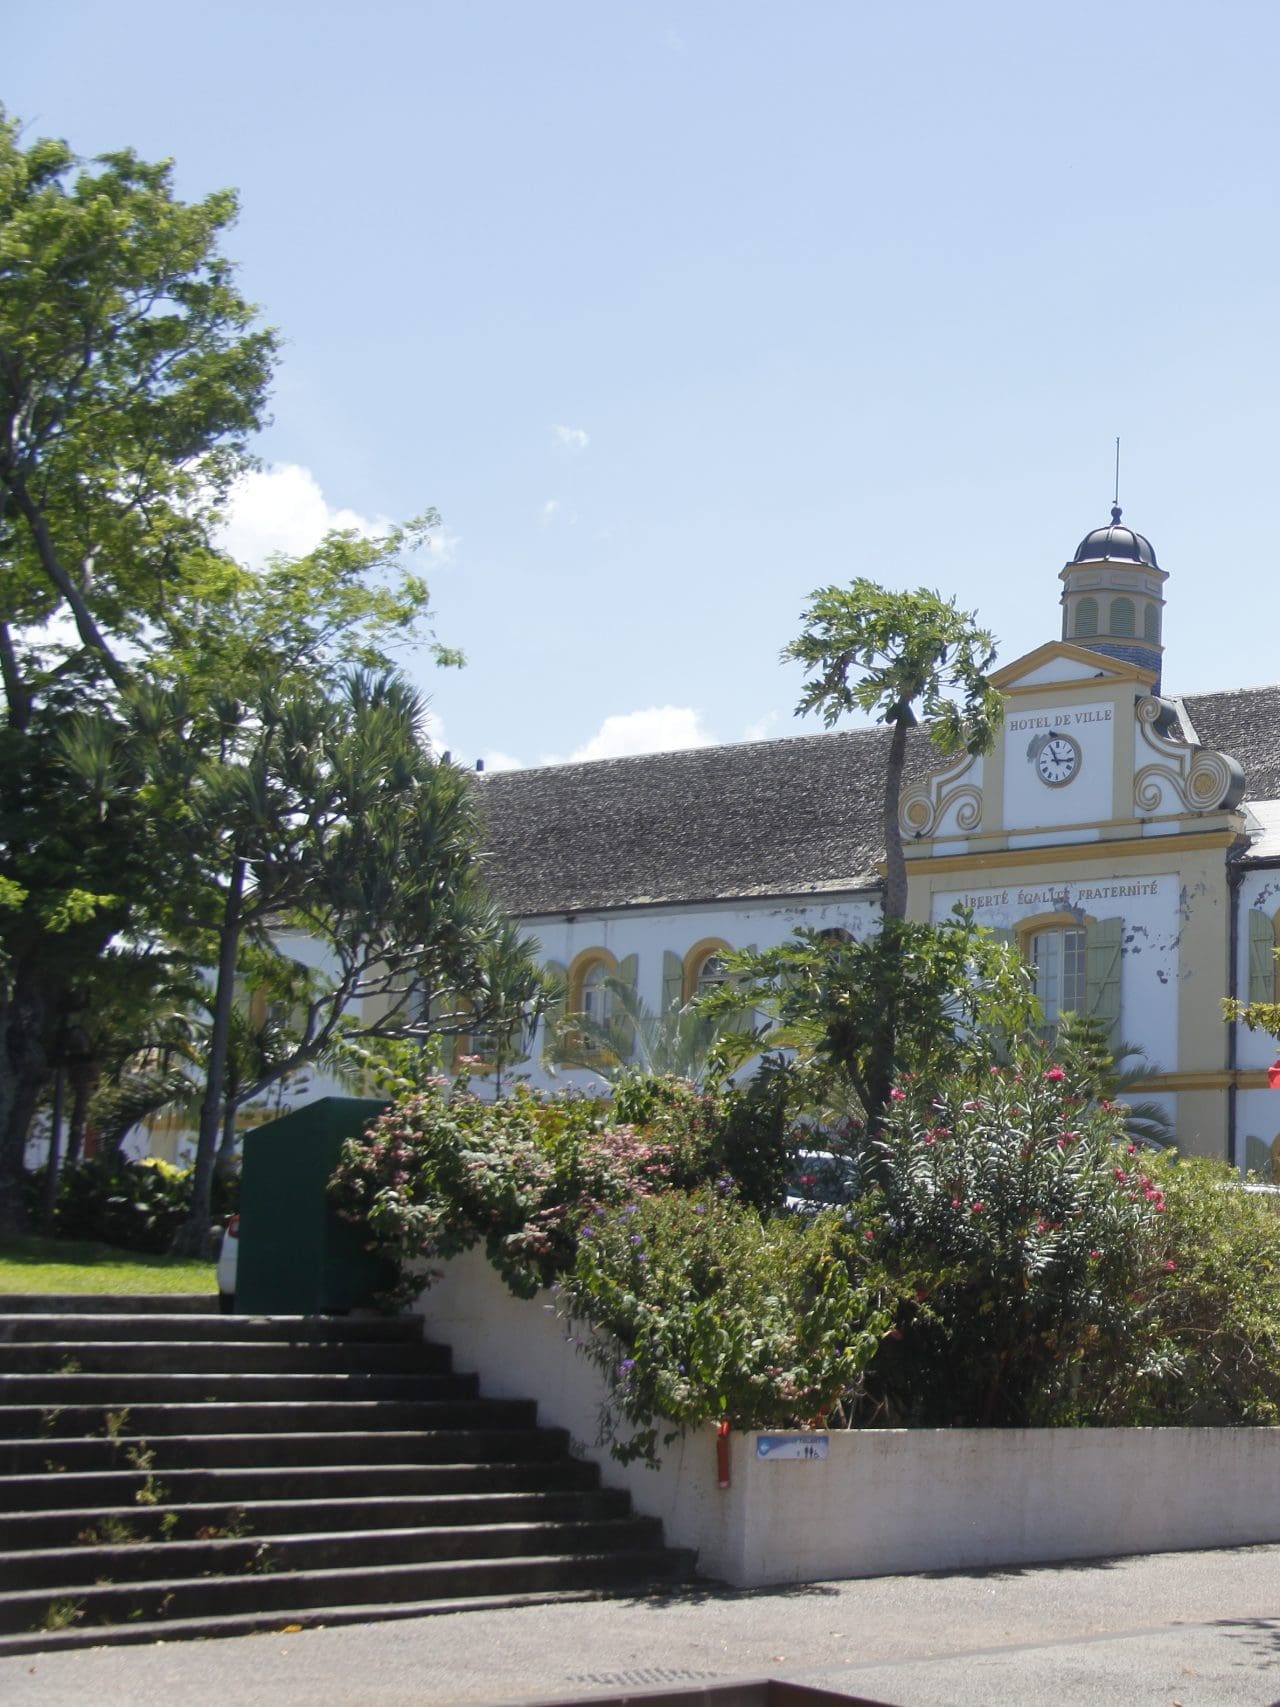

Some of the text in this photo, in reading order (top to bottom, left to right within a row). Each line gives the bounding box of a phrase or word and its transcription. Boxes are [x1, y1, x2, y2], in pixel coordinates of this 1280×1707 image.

[1010, 709, 1112, 731] HOTEL DE VILLE
